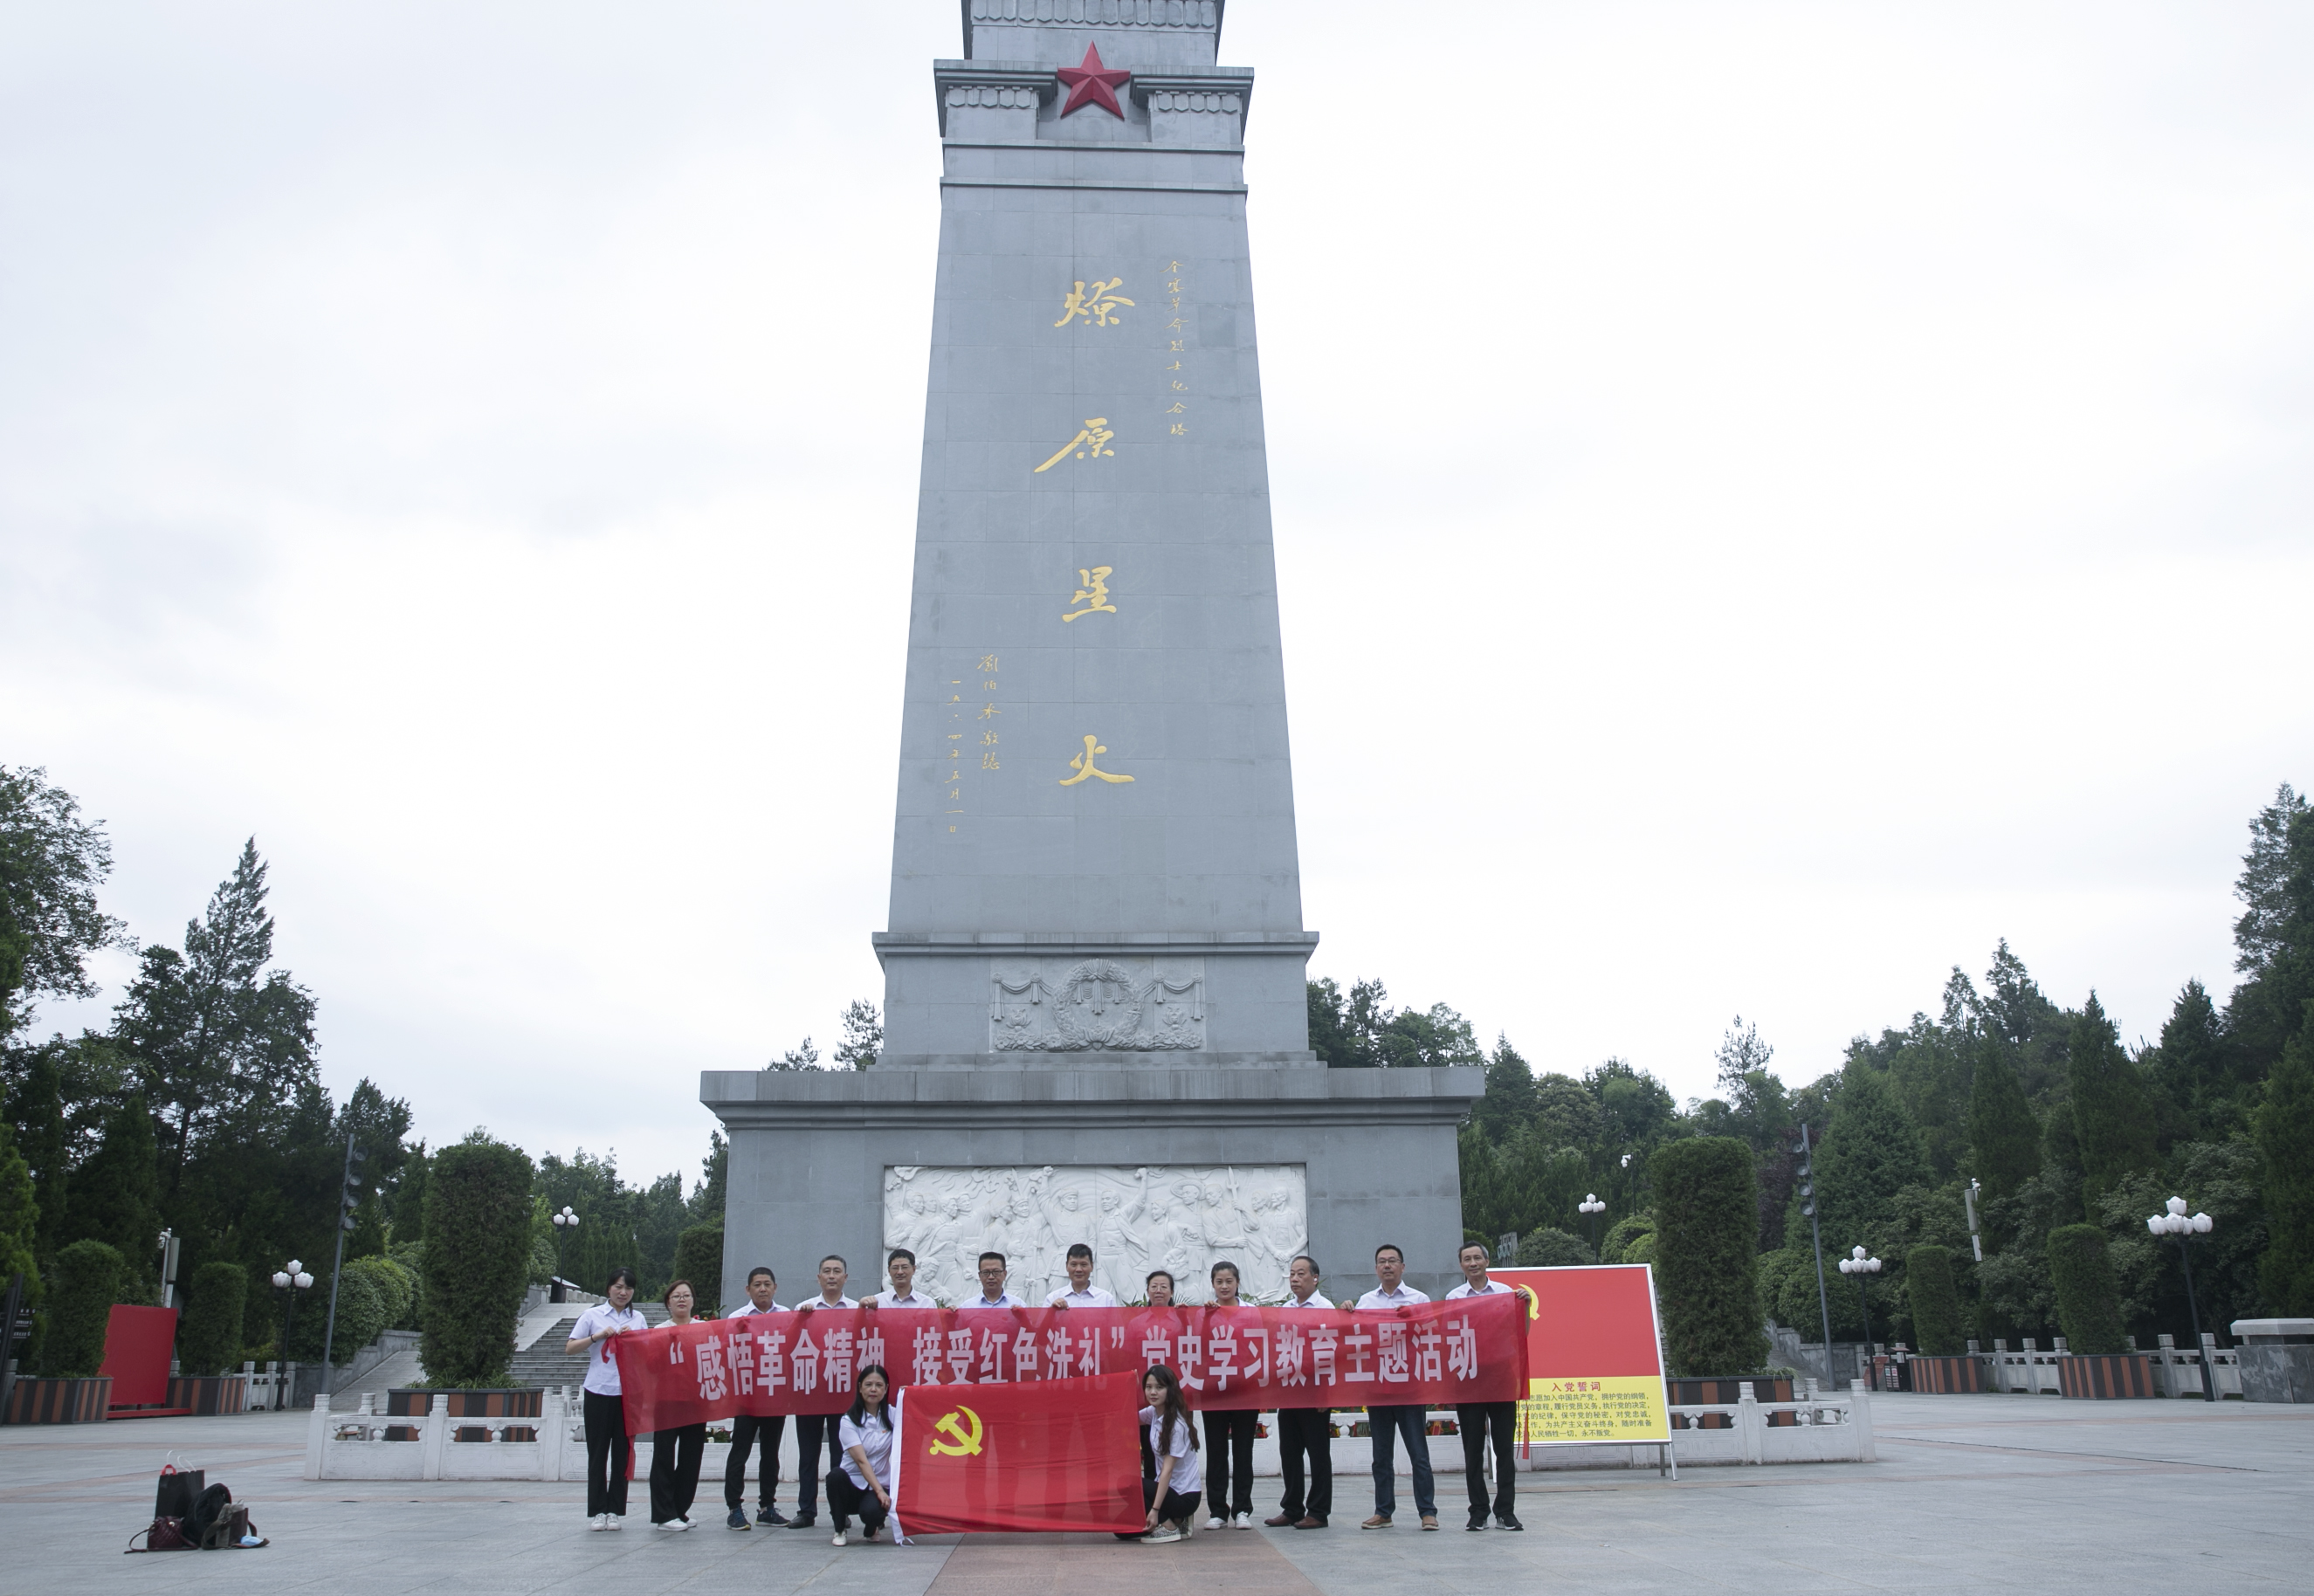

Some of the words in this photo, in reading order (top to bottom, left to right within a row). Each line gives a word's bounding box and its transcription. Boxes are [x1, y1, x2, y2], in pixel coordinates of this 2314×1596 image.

[1034, 277, 1135, 787] 燎原星火
[1552, 1381, 1601, 1393] 入党誓词
[1522, 1392, 1649, 1402] 志愿加入中国共产党，拥护党的纲领，
[1516, 1401, 1650, 1411] 党的章程，履行党员义务，执行党的决定，
[1515, 1428, 1615, 1439] 党人民牺牲一切，永不叛党。
